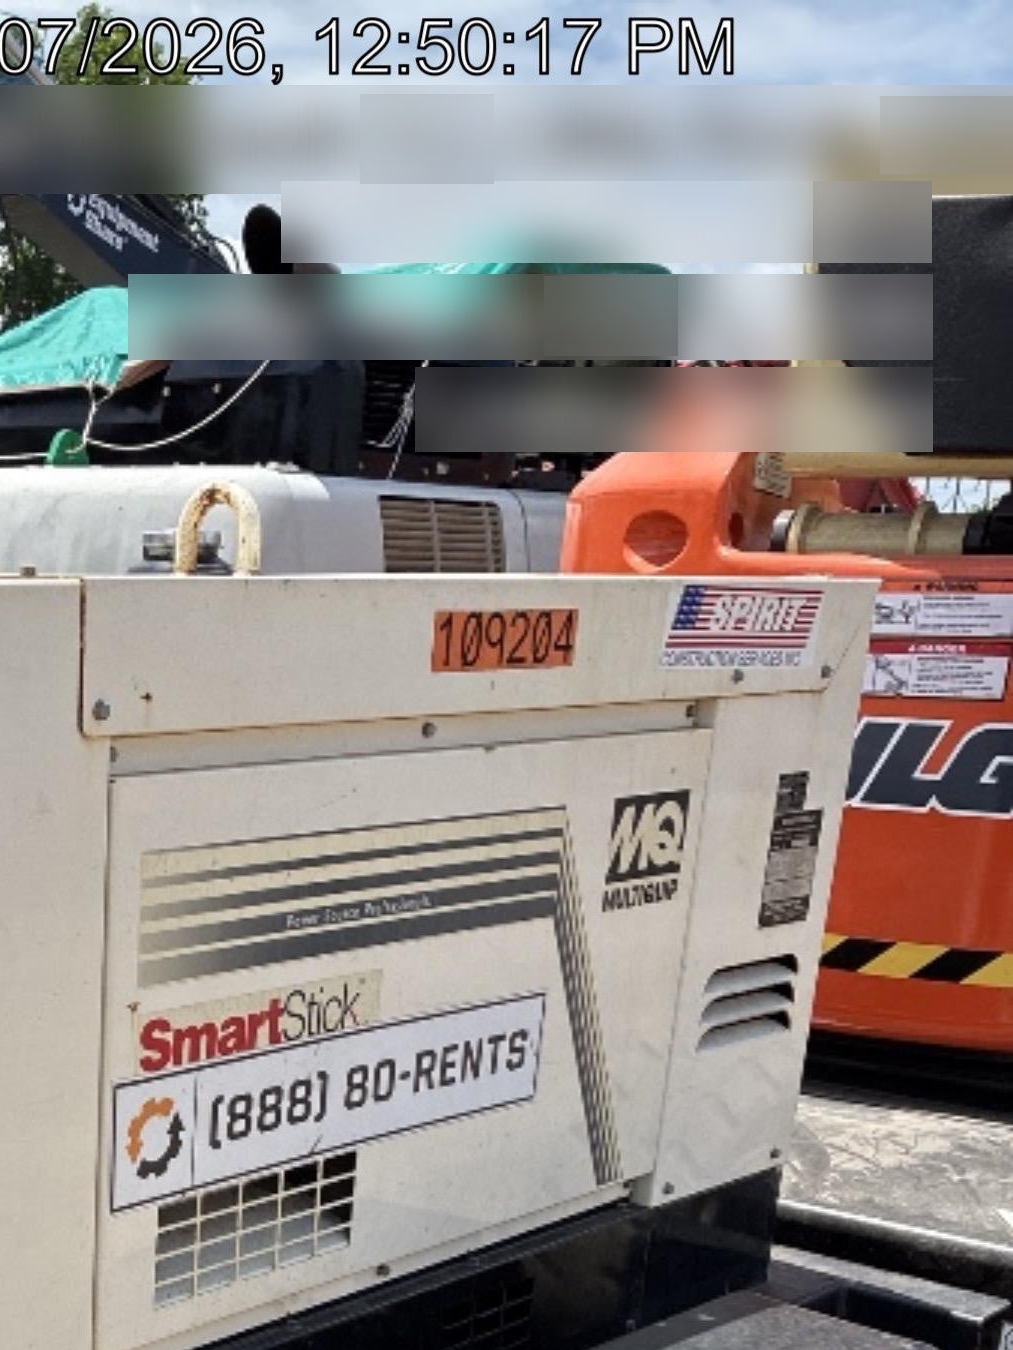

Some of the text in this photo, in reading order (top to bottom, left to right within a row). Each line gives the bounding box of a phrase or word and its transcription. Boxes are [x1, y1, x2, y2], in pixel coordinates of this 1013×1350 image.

[439, 611, 573, 667] 109204
[710, 596, 807, 631] SPIRIT
[608, 799, 686, 875] MQ
[139, 983, 362, 1073] SmartStick
[208, 1028, 529, 1149] (888) 80-RENTS
